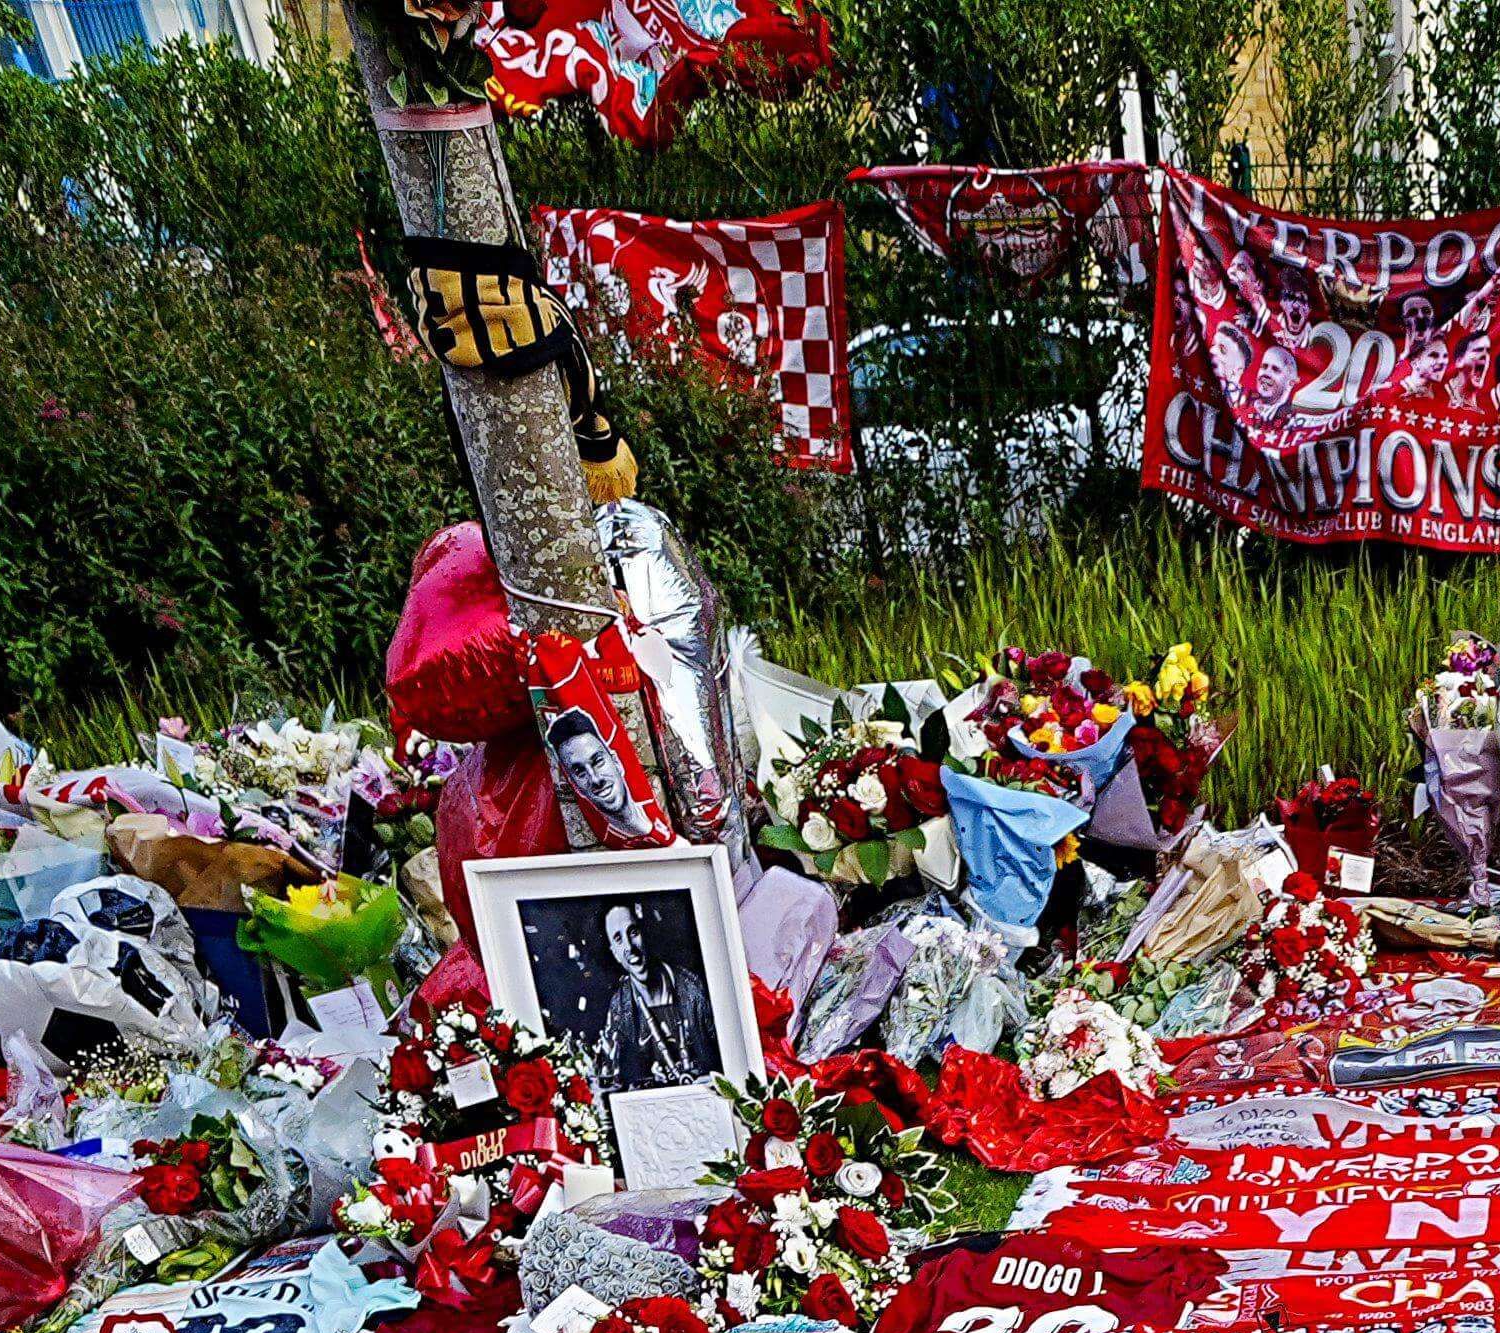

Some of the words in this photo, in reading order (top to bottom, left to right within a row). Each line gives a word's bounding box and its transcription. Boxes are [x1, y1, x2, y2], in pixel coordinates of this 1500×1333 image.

[1297, 322, 1396, 412] 20
[1390, 515, 1414, 534] IN
[459, 1139, 505, 1168] DIOGO
[991, 1256, 1082, 1297] DIOGO
